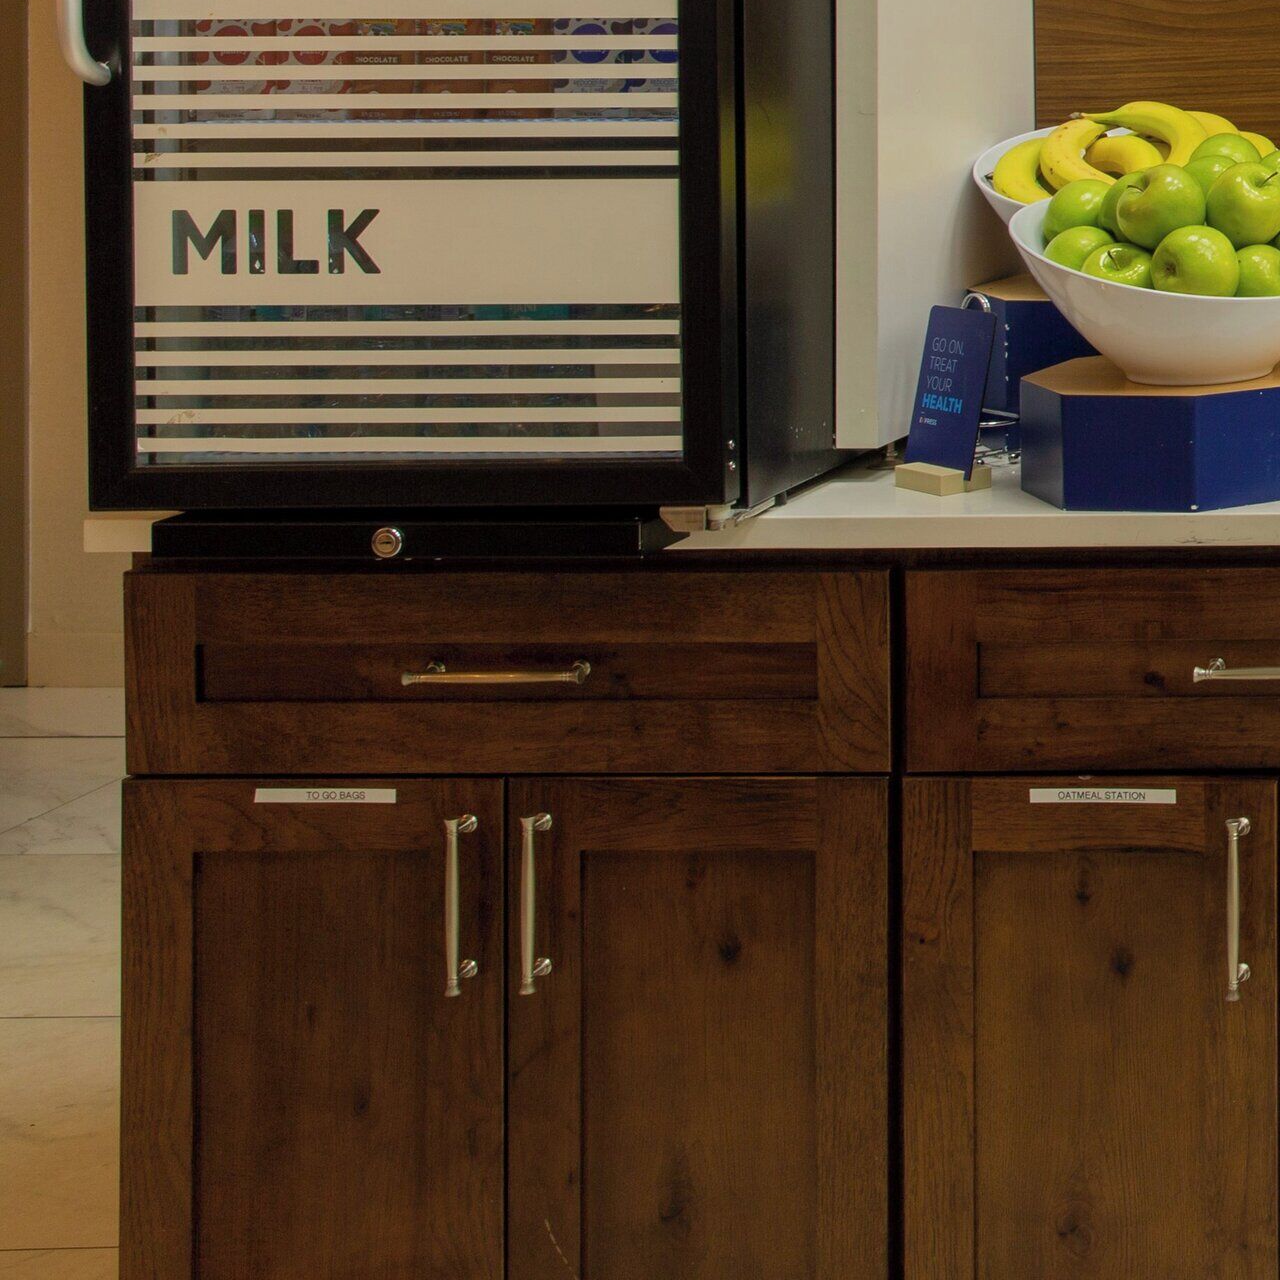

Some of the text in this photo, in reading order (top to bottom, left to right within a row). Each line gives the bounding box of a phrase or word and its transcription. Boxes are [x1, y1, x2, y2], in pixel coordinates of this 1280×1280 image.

[172, 209, 381, 276] MILK
[932, 337, 946, 351] GO
[929, 355, 958, 372] TREAT
[926, 375, 952, 391] YOUR
[921, 392, 962, 414] HEALTH
[306, 791, 366, 799] TO GO BAGS
[1057, 791, 1146, 800] OATMEAL STATION
